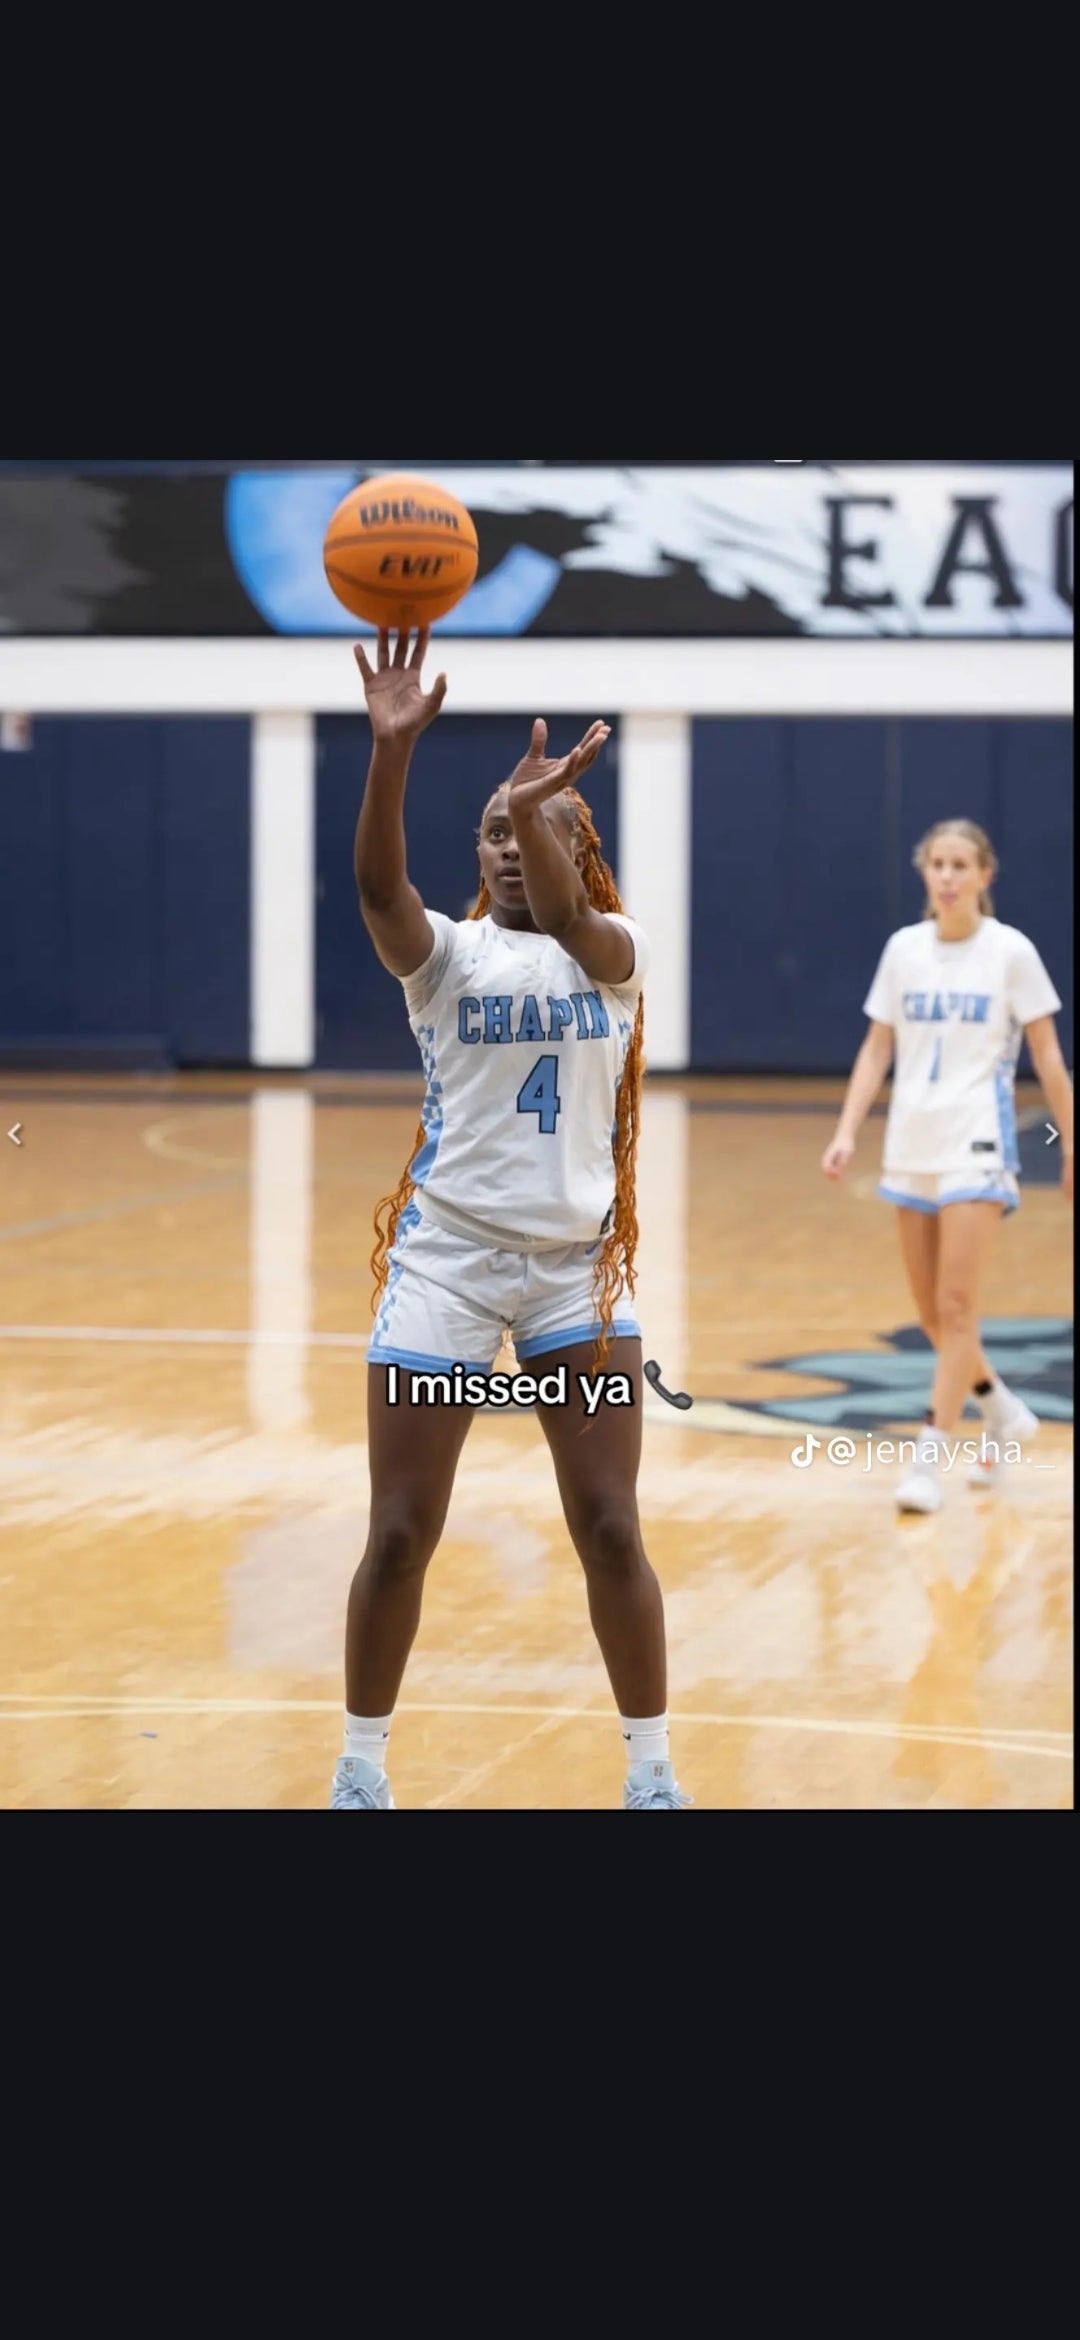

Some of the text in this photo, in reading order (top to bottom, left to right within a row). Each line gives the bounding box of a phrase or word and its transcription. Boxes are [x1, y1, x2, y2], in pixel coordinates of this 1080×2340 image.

[359, 499, 459, 530] Wilson
[822, 496, 1074, 608] EA
[458, 990, 610, 1044] CHAPIN
[902, 992, 991, 1022] CHAPIN
[517, 1055, 560, 1134] 4
